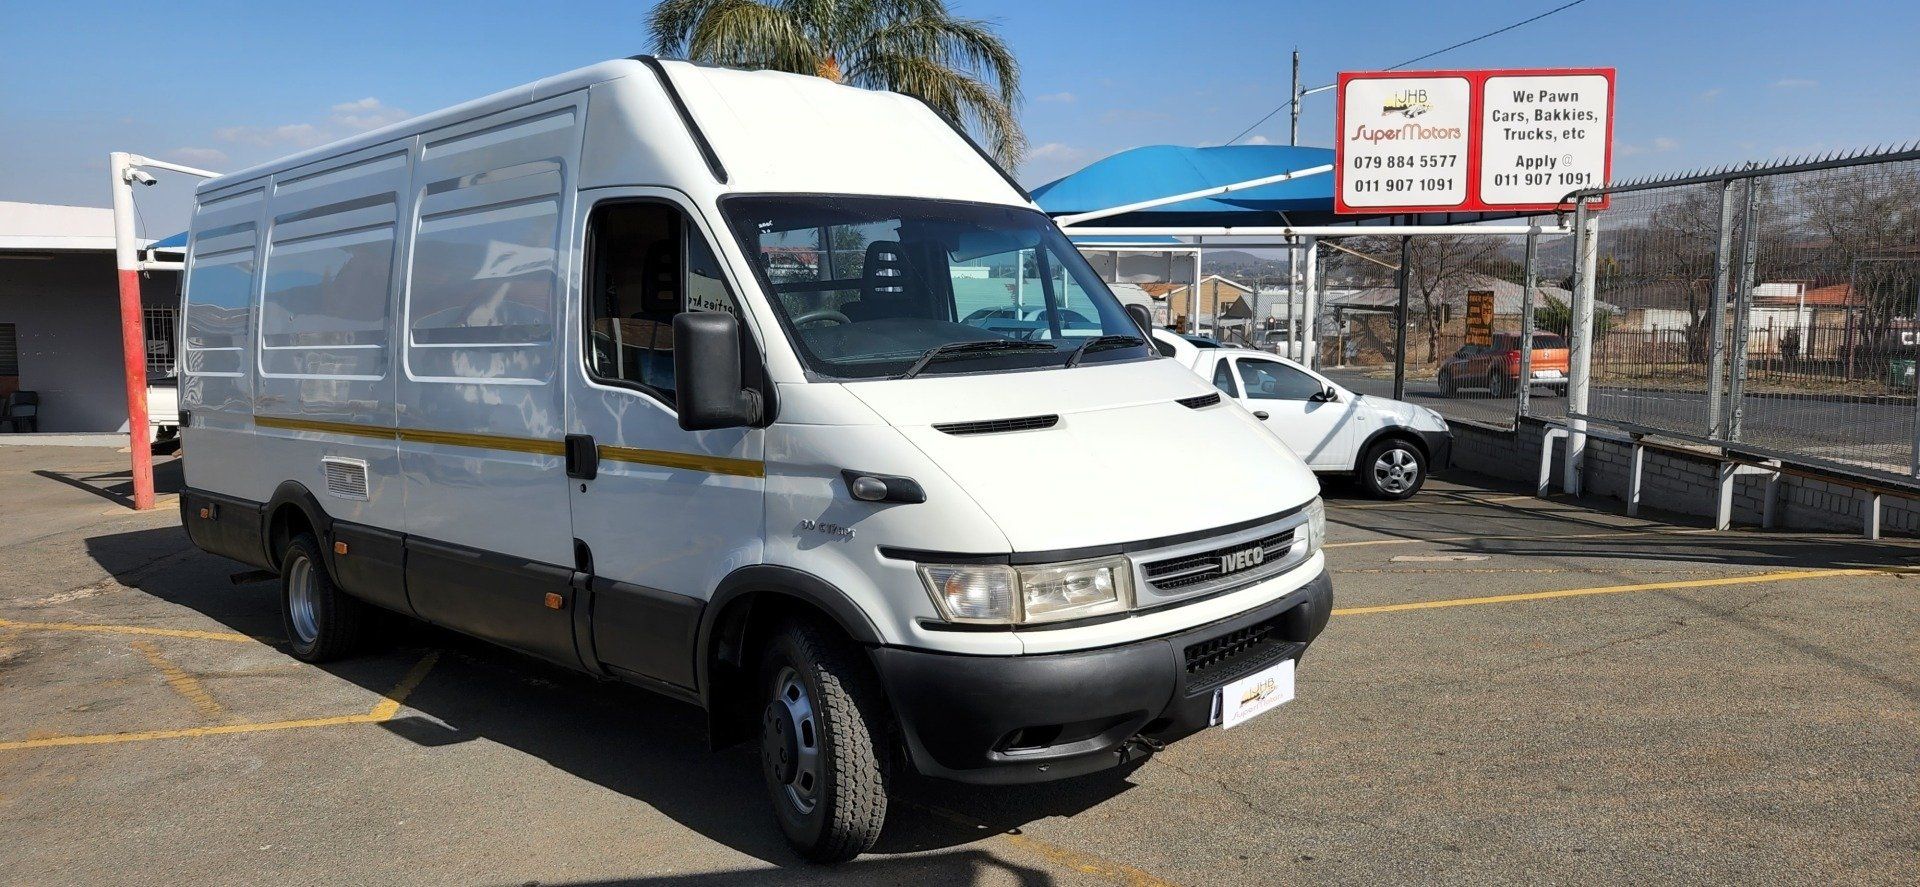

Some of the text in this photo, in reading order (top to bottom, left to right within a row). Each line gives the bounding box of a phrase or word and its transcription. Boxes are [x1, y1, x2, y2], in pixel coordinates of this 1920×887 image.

[1397, 89, 1428, 103] JHB
[1513, 90, 1579, 103] We Pawn
[1492, 108, 1598, 124] Cars, Bakkies,
[1351, 123, 1462, 145] SuperMotors
[1503, 127, 1585, 142] Trucks, etc
[1354, 154, 1457, 169] 079 884 5577
[1516, 155, 1557, 170] Apply
[1355, 178, 1453, 192] 011 907 1091
[1494, 172, 1592, 186] 011 907 1091
[1221, 546, 1264, 574] IVECO
